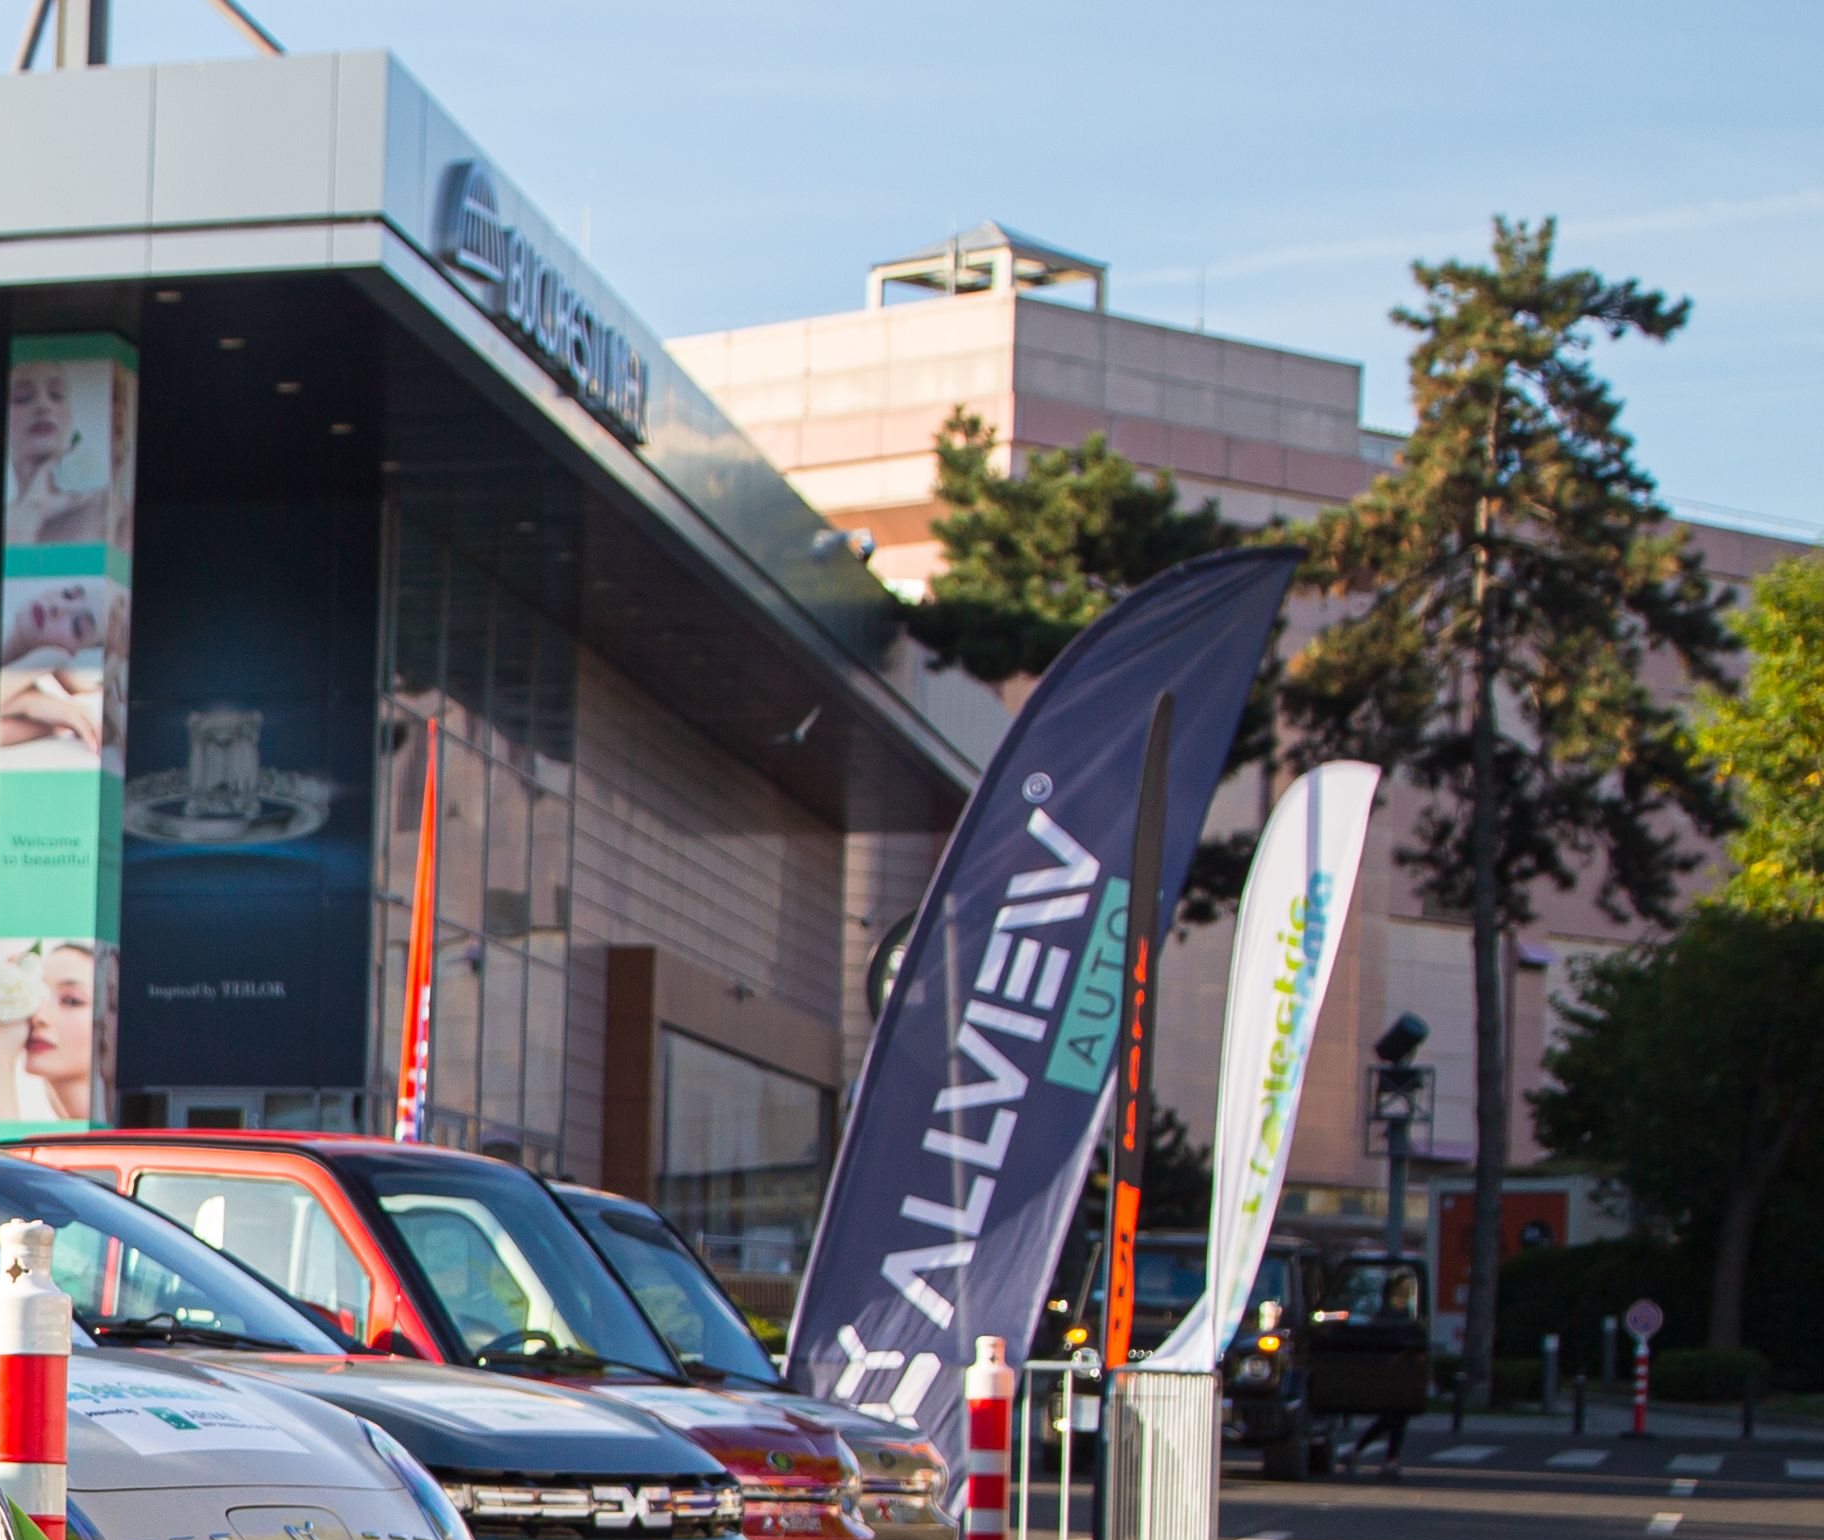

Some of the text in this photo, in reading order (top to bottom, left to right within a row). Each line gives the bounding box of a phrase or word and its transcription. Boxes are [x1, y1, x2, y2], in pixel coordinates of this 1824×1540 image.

[2, 851, 90, 867] to beautiful
[12, 834, 81, 847] Welcome
[1067, 904, 1130, 1068] AUTO
[880, 806, 1102, 1330] ALLVIEW
